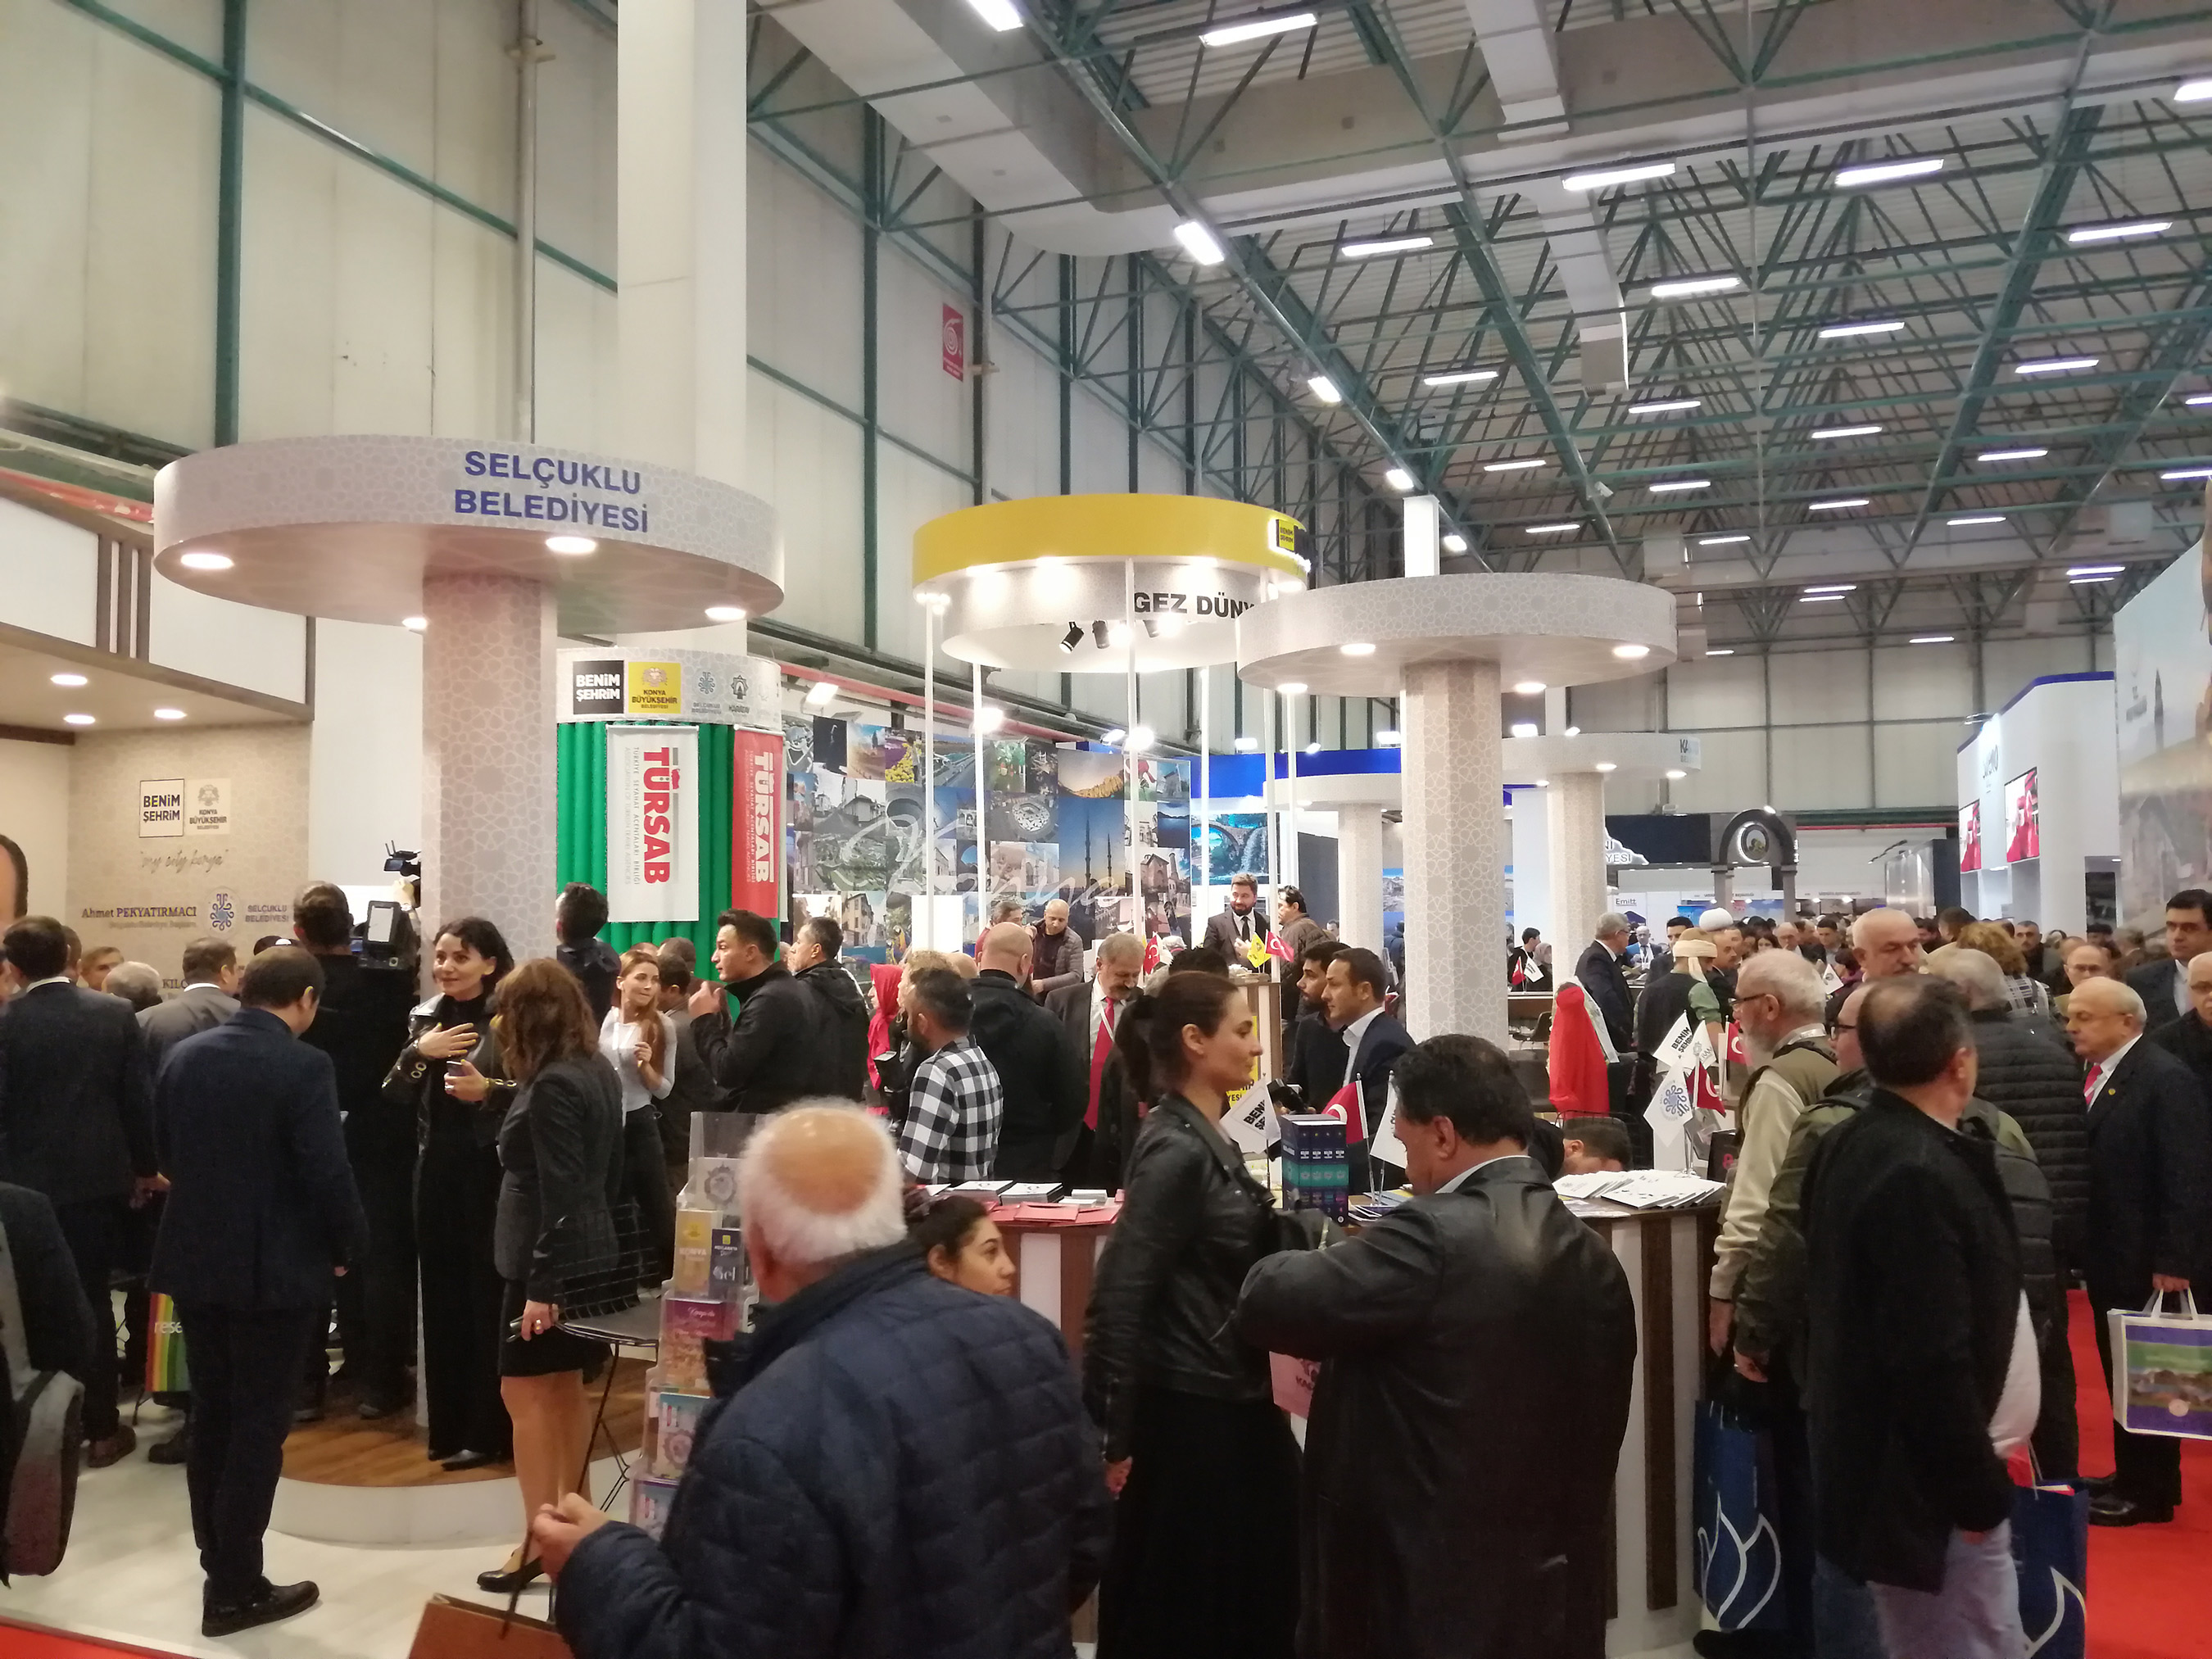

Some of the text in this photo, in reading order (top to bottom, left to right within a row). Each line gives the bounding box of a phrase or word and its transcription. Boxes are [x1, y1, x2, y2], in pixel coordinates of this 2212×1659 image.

[465, 451, 640, 495] SELÇUKLU
[455, 488, 648, 533] BELEDİYESİ
[1134, 592, 1187, 613] GEZ
[643, 746, 671, 885] TÜRSAB
[754, 750, 770, 883] TÜRSAB
[81, 906, 197, 918] Ahmet PEKYATIRMACI
[1616, 898, 1637, 906] Emitt
